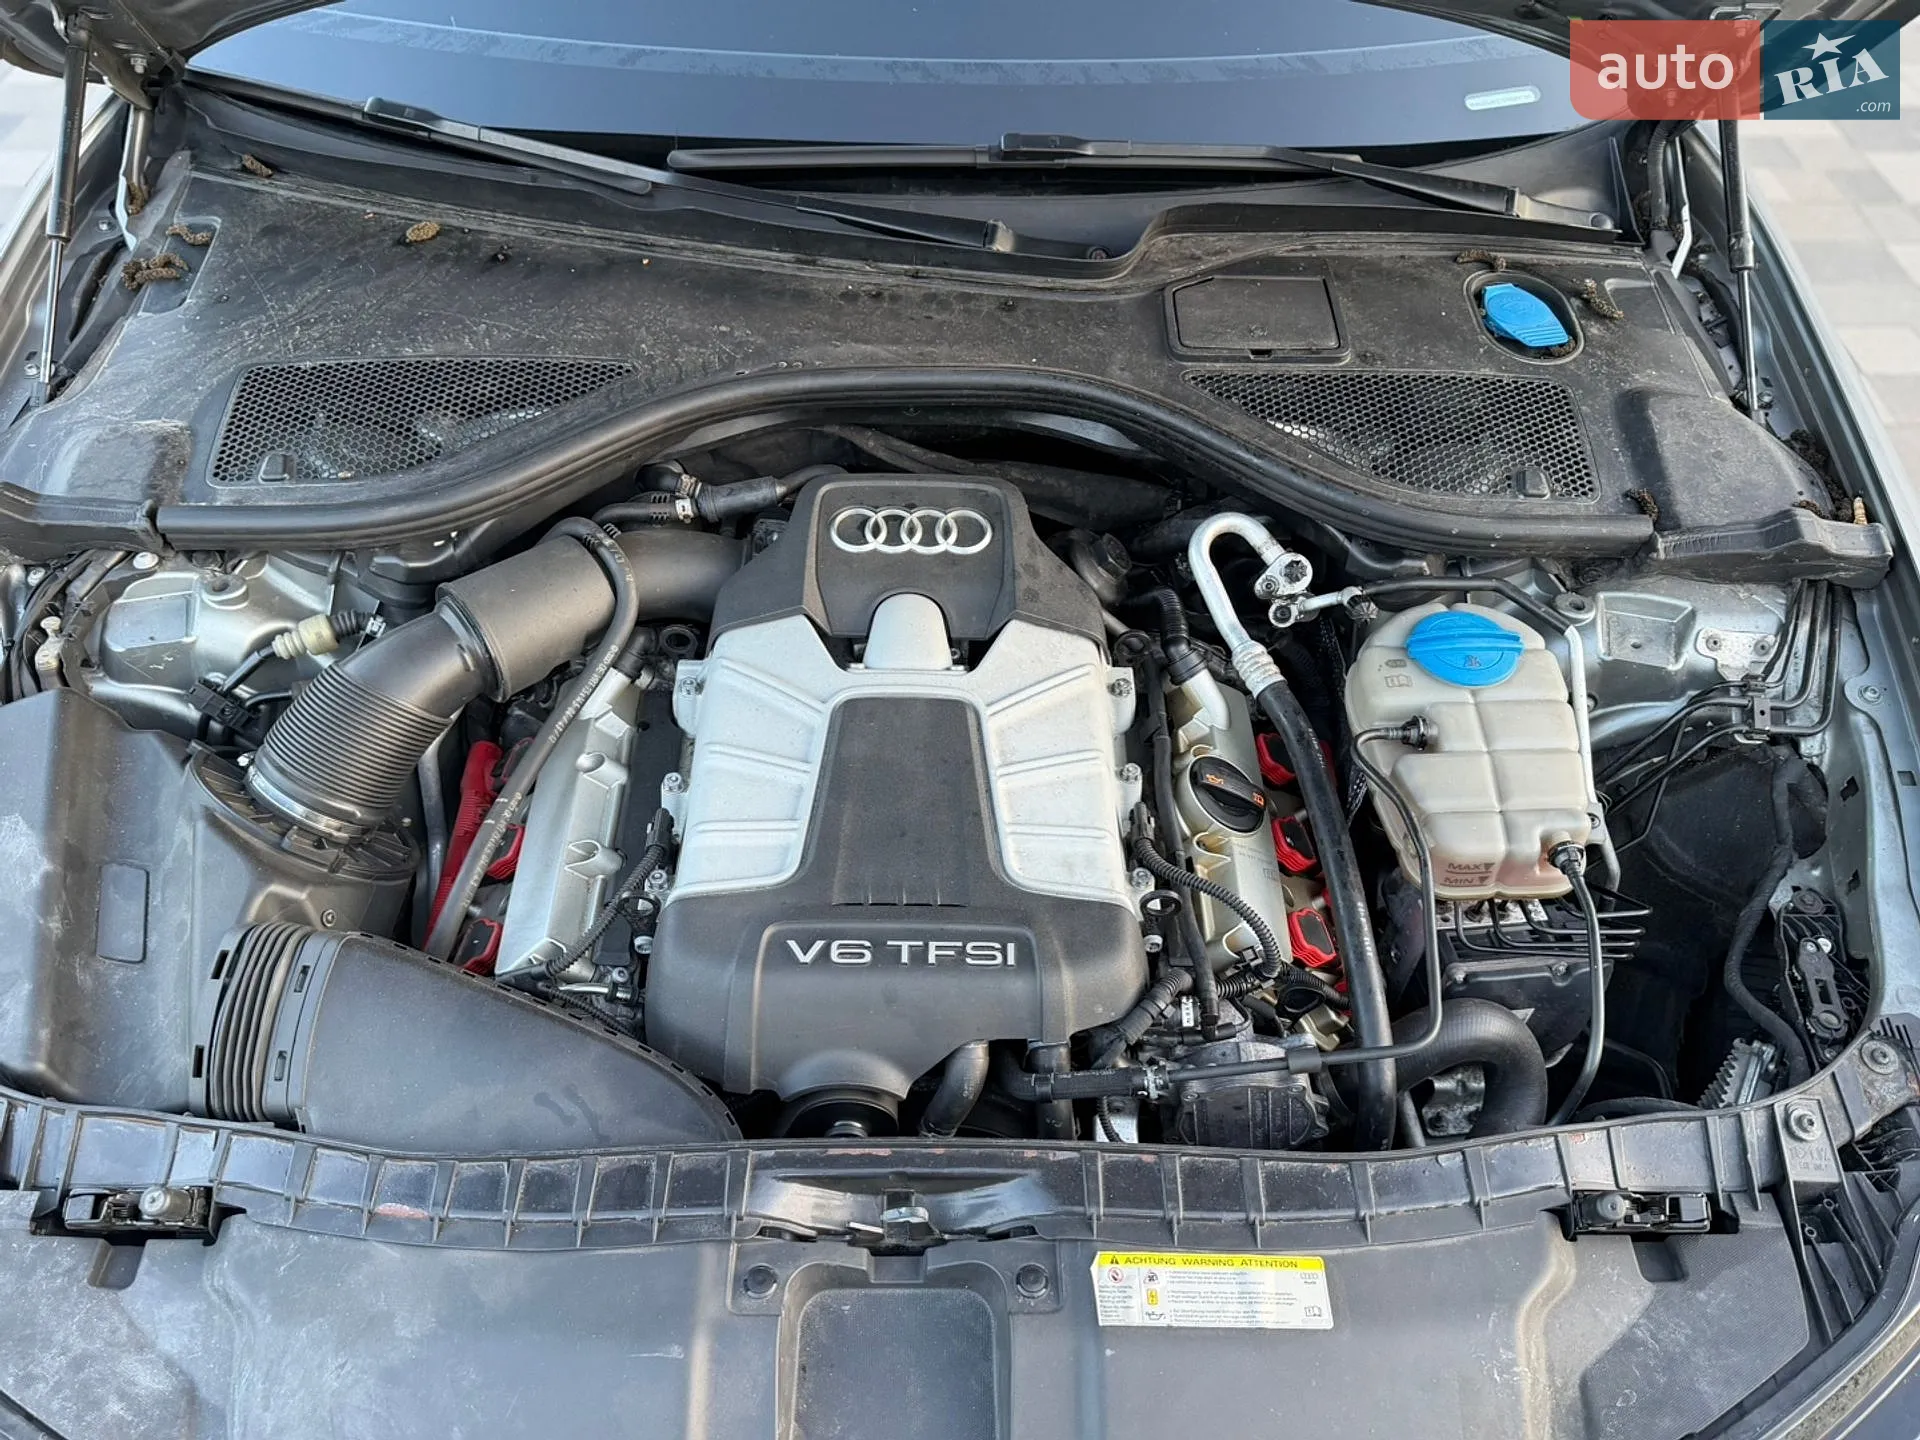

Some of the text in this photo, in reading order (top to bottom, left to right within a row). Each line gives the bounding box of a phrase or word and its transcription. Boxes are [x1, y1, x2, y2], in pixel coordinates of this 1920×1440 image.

[1447, 862, 1481, 871] MAX
[1443, 876, 1474, 884] MIN
[786, 939, 1016, 967] V6 TFSI
[1124, 1256, 1299, 1268] ACHTUNG WARNING ATTENTION
